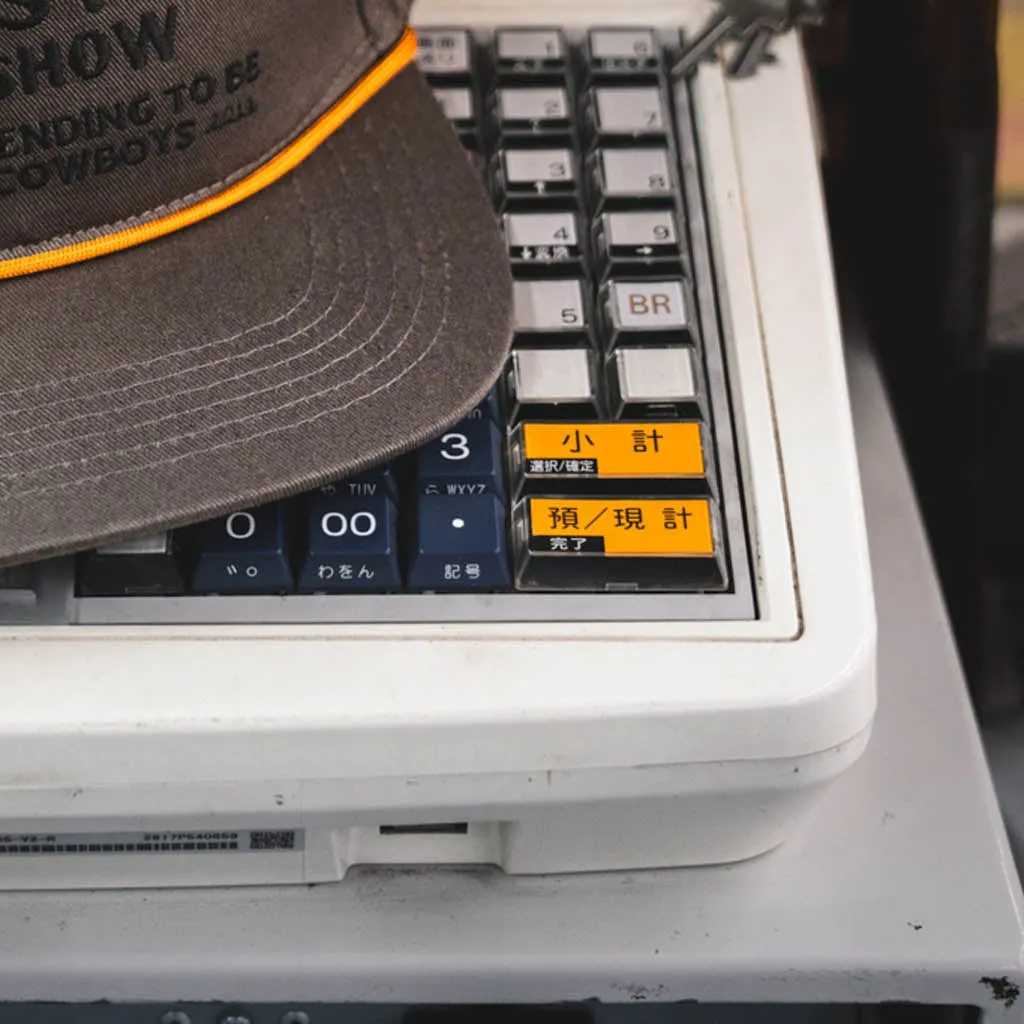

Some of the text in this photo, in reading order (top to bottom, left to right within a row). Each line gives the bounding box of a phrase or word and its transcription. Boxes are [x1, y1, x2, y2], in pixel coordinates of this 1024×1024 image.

[163, 72, 217, 110] TO
[225, 50, 262, 93] BE
[553, 226, 569, 241] 4
[653, 225, 670, 240] 9
[628, 294, 672, 315] BR
[561, 308, 578, 324] 5
[440, 432, 471, 460] 3
[561, 429, 664, 454] 小計
[529, 459, 595, 474] 選択/確定
[226, 511, 256, 539] 0
[321, 511, 377, 537] 00
[549, 537, 588, 551] 完了
[317, 564, 375, 580] わをん
[443, 563, 481, 579] 記号
